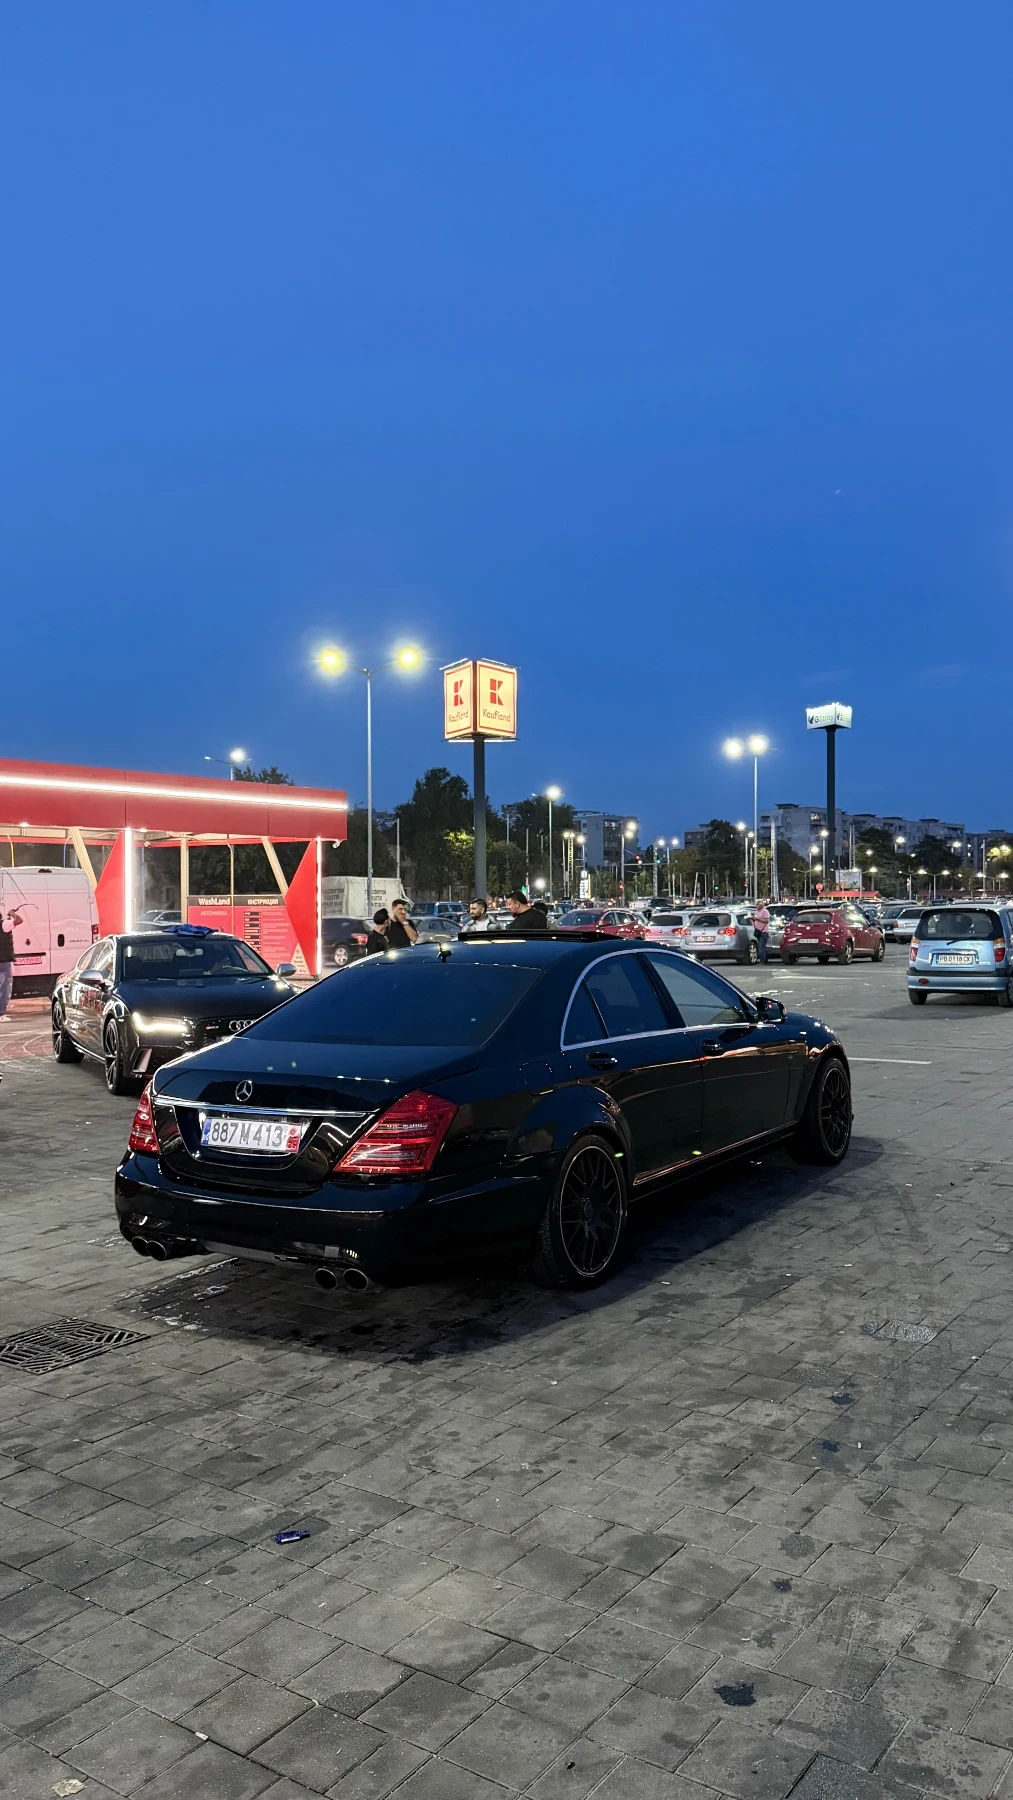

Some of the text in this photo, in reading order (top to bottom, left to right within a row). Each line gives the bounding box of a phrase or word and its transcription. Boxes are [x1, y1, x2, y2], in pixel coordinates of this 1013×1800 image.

[489, 678, 504, 706] K
[448, 709, 469, 723] Kaufland
[482, 708, 511, 723] Kaufland
[198, 897, 231, 906] WashLand
